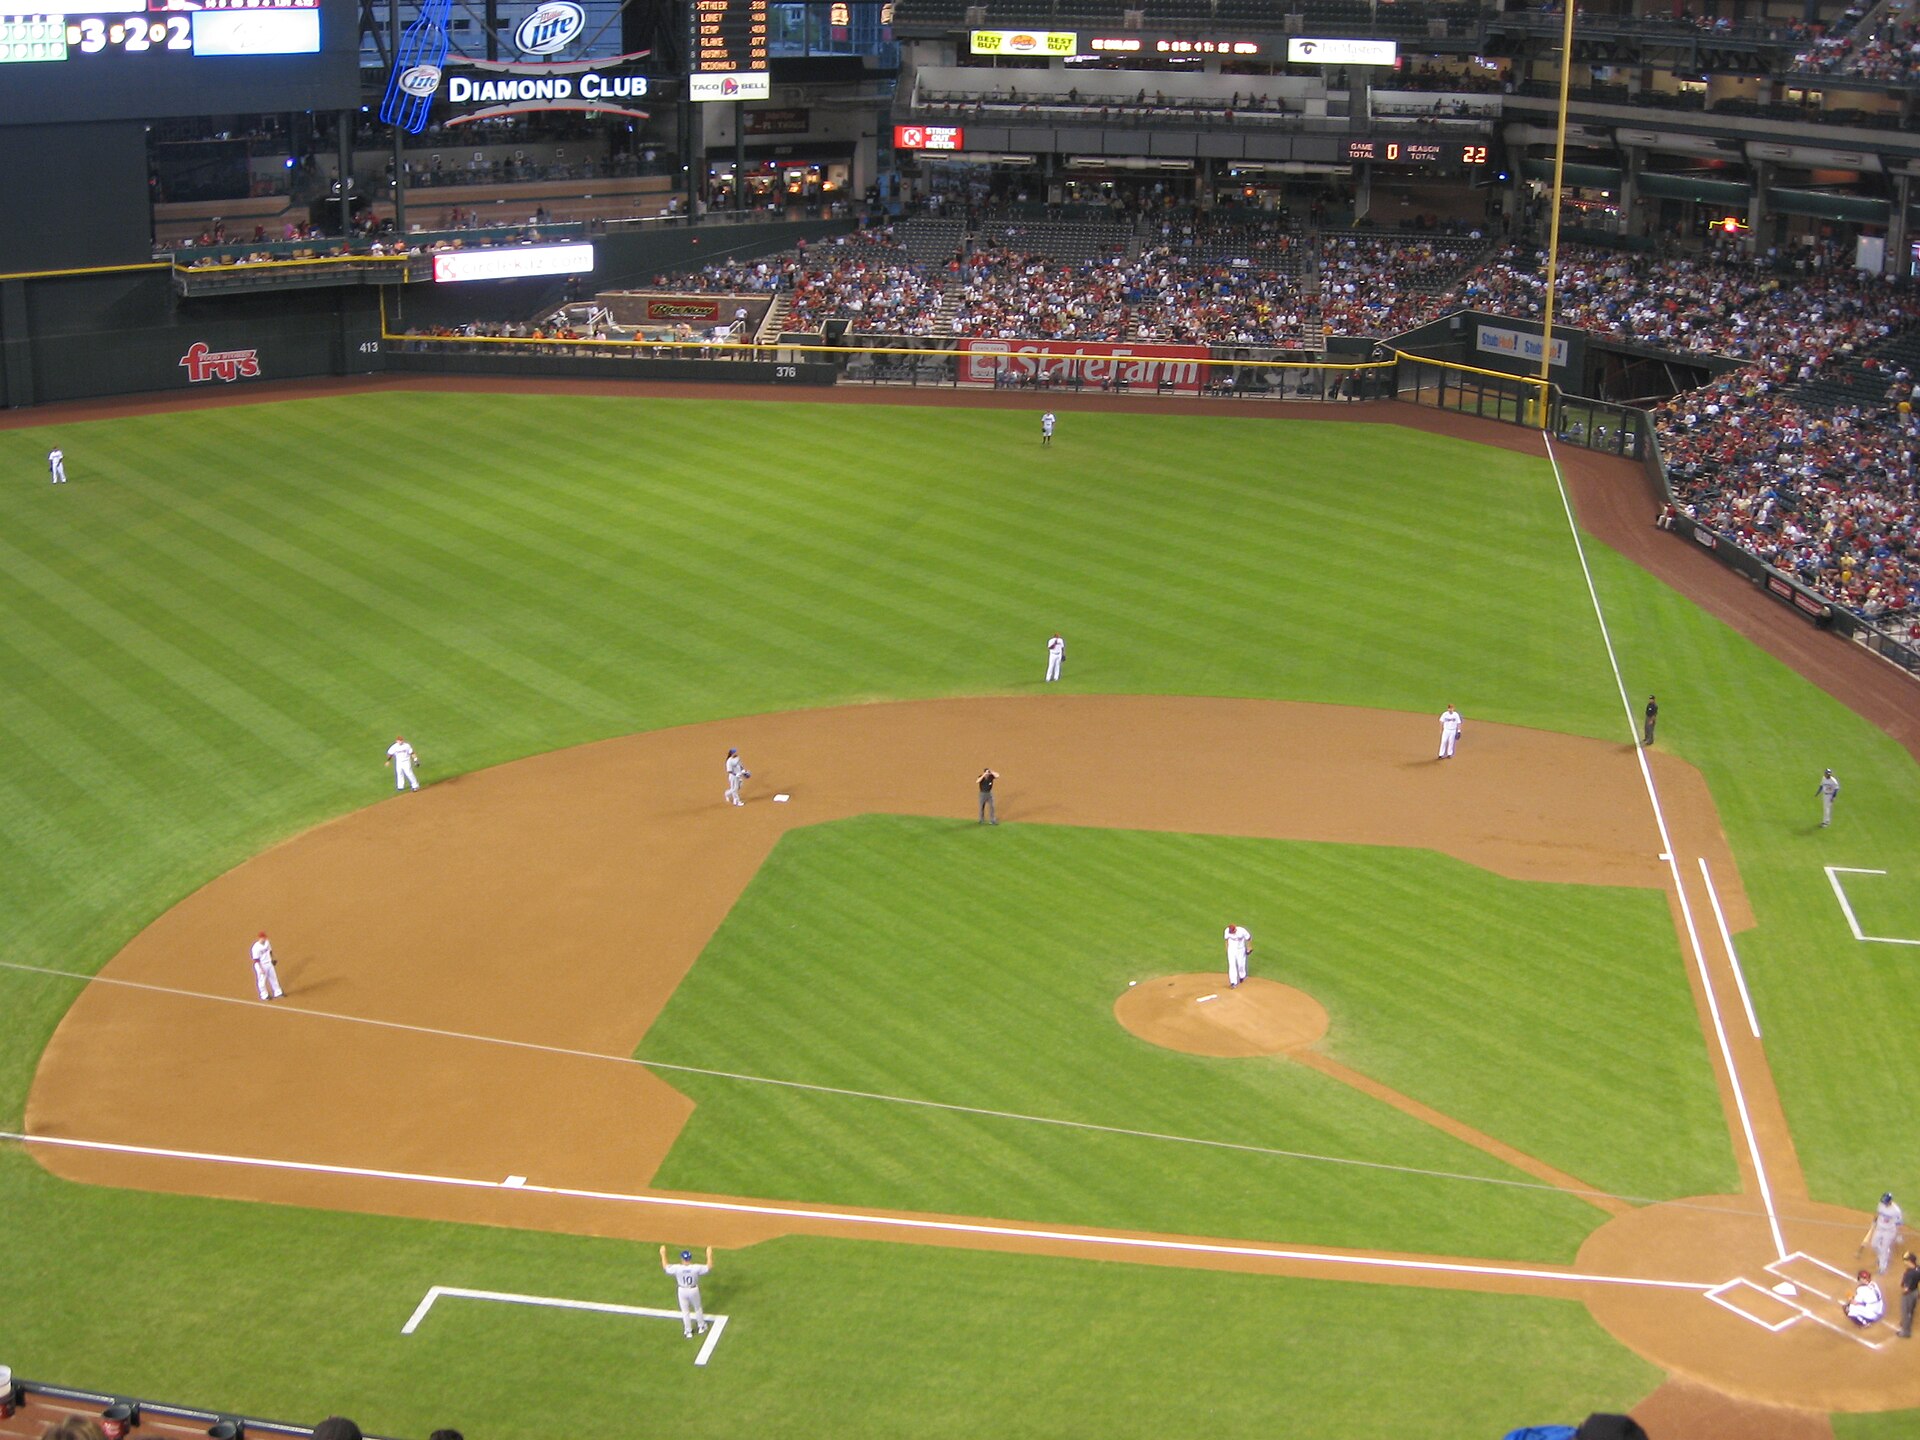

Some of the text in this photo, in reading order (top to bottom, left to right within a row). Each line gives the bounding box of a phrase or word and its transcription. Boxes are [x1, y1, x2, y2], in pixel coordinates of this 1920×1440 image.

[80, 18, 106, 53] 3
[110, 25, 125, 43] S
[124, 18, 150, 51] 2
[166, 17, 192, 50] 2
[530, 16, 574, 48] Lite
[977, 35, 1002, 44] BEST
[1047, 36, 1073, 44] BEST
[977, 42, 1000, 50] BUY
[1048, 43, 1070, 51] BUY
[408, 75, 438, 89] Lite
[741, 82, 767, 90] BELL
[449, 73, 648, 102] DIAMOND CLUB
[925, 127, 957, 136] STRIKE
[931, 134, 950, 142] OUT
[1350, 143, 1373, 151] GAME
[1387, 144, 1398, 160] 0
[1407, 145, 1440, 153] SEASON
[1463, 146, 1486, 163] 22
[360, 341, 378, 353] 413
[776, 366, 796, 378] 376
[682, 1275, 693, 1286] 10
